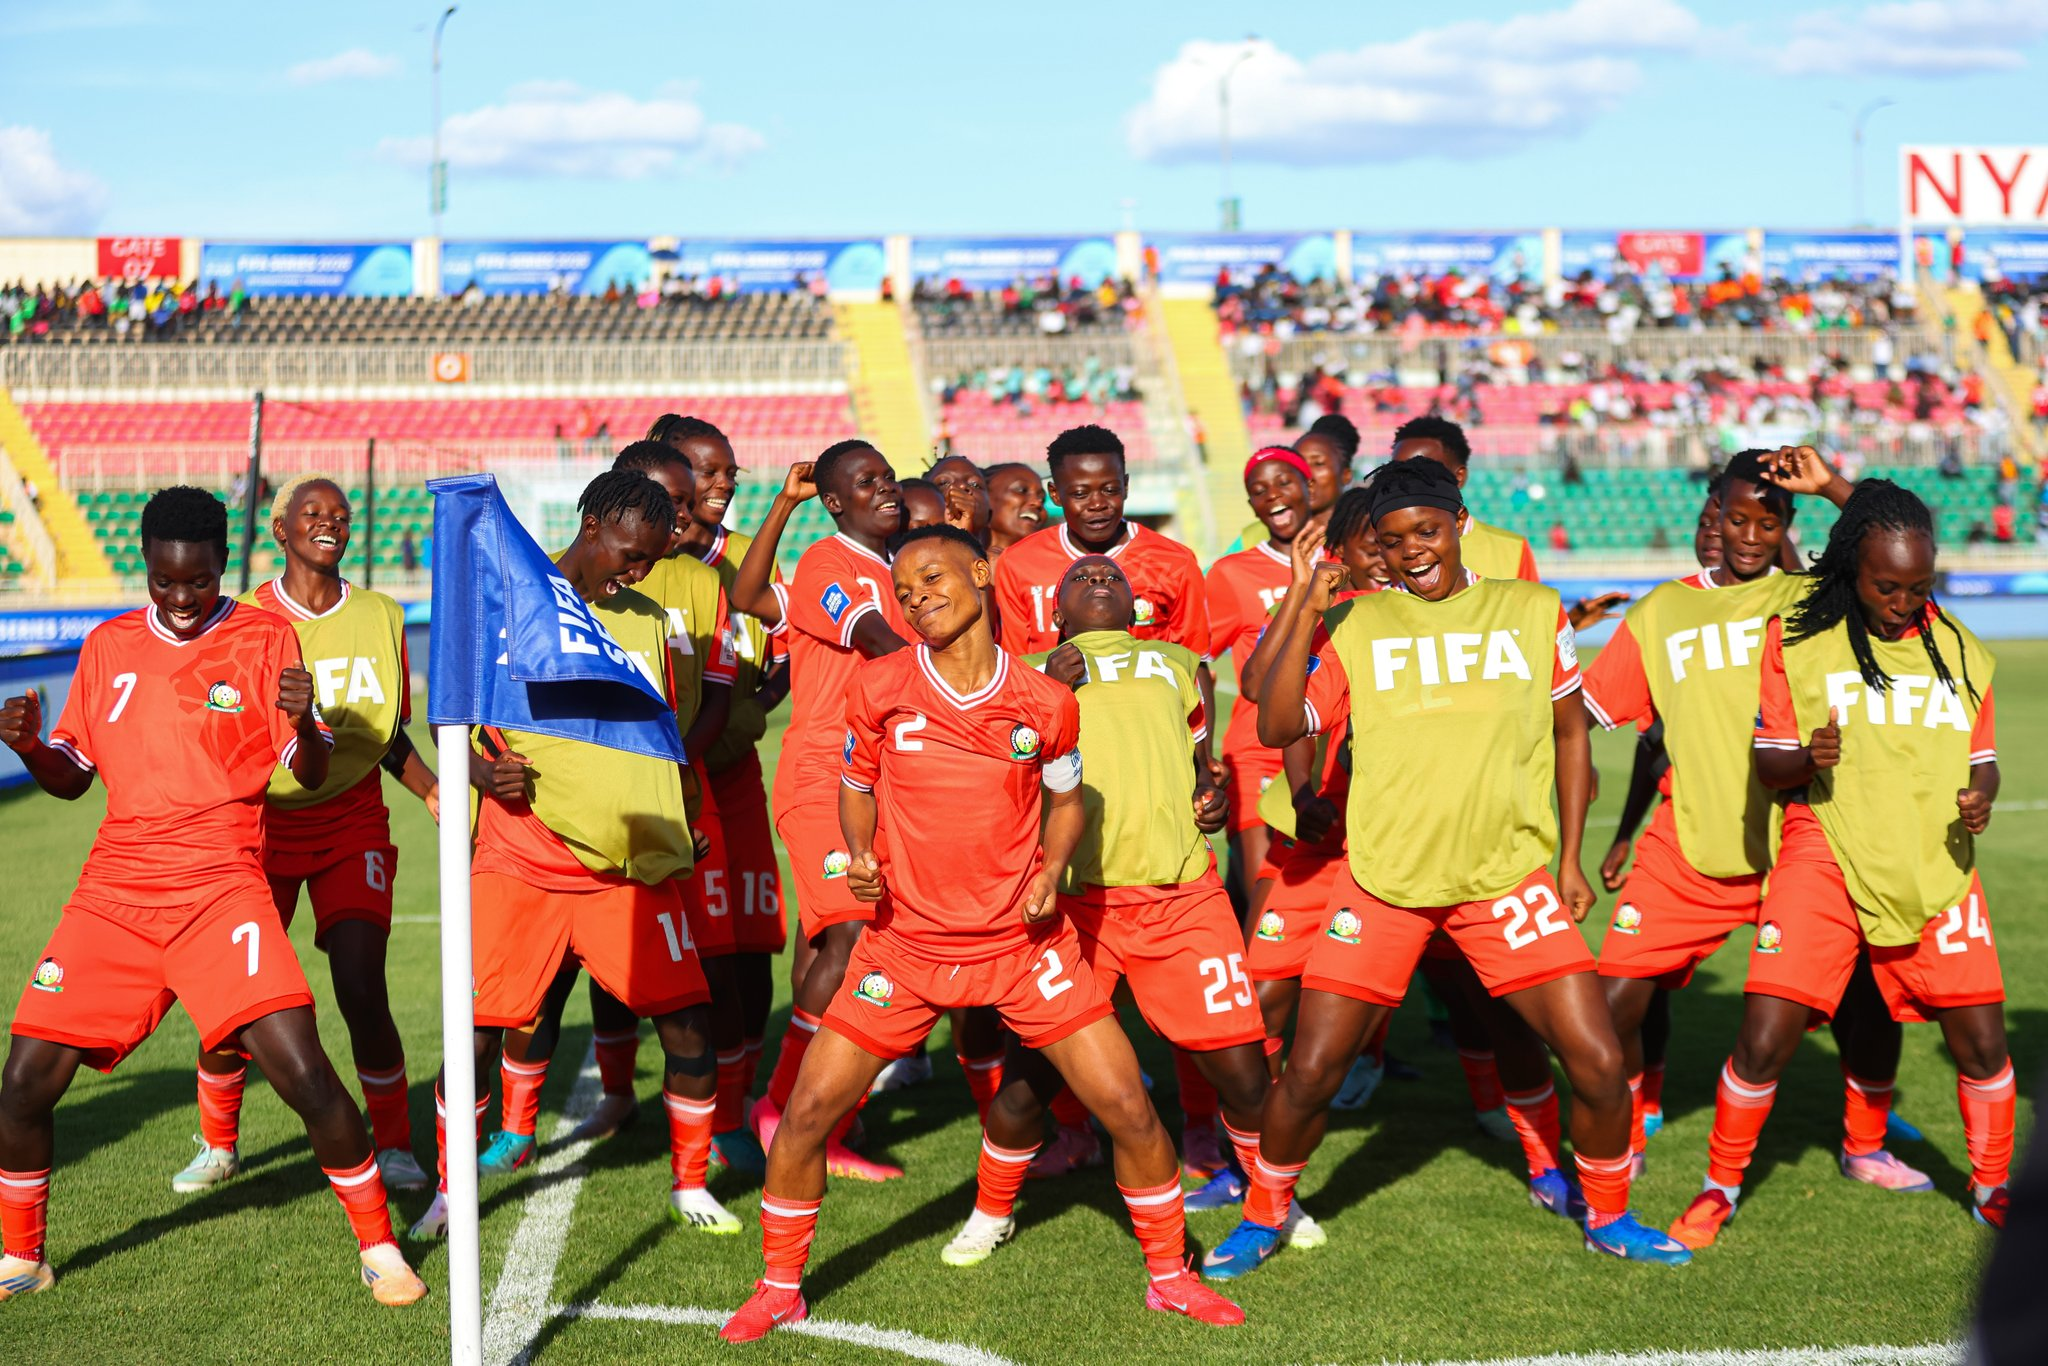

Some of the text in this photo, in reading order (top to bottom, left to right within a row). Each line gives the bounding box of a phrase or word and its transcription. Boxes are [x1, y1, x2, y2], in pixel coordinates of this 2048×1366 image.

[1909, 152, 2048, 217] NY
[111, 238, 165, 258] GATE
[0, 618, 57, 642] SERIES
[546, 573, 600, 656] FIFA
[1372, 629, 1533, 692] FIFA
[1666, 616, 1764, 683] FIF
[108, 672, 138, 723] 7
[314, 656, 386, 709] FA
[1825, 671, 1972, 732] FIFA
[895, 715, 927, 752] 2
[364, 851, 387, 892] 6
[704, 870, 729, 918] 5
[741, 872, 780, 918] 16
[1492, 885, 1569, 950] 22
[1935, 894, 1991, 955] 24
[232, 921, 260, 977] 7
[1032, 949, 1074, 1001] 2
[1199, 952, 1252, 1014] 25
